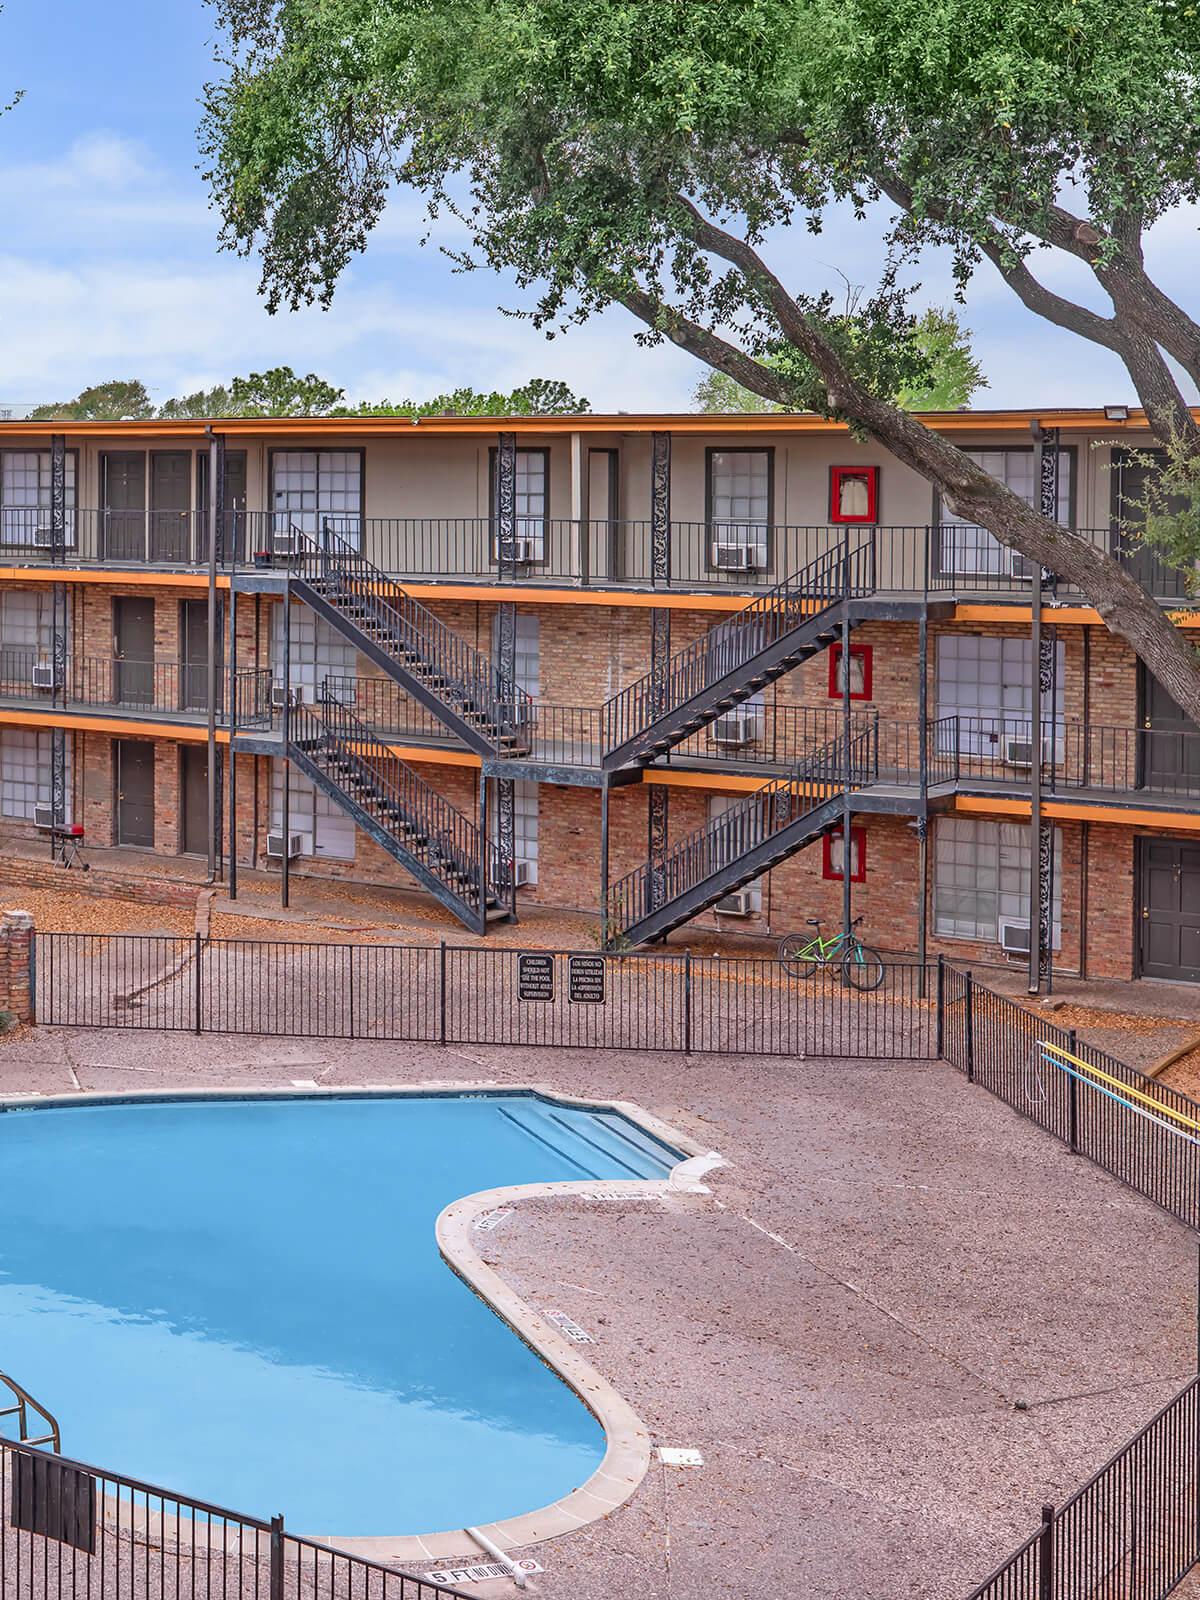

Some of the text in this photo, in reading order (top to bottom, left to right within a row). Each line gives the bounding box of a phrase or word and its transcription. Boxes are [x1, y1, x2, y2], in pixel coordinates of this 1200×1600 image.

[522, 966, 540, 974] SHOULD
[520, 982, 539, 990] WITHOUT
[431, 1572, 448, 1583] 5
[450, 1569, 473, 1581] FT
[472, 1567, 489, 1578] NO
